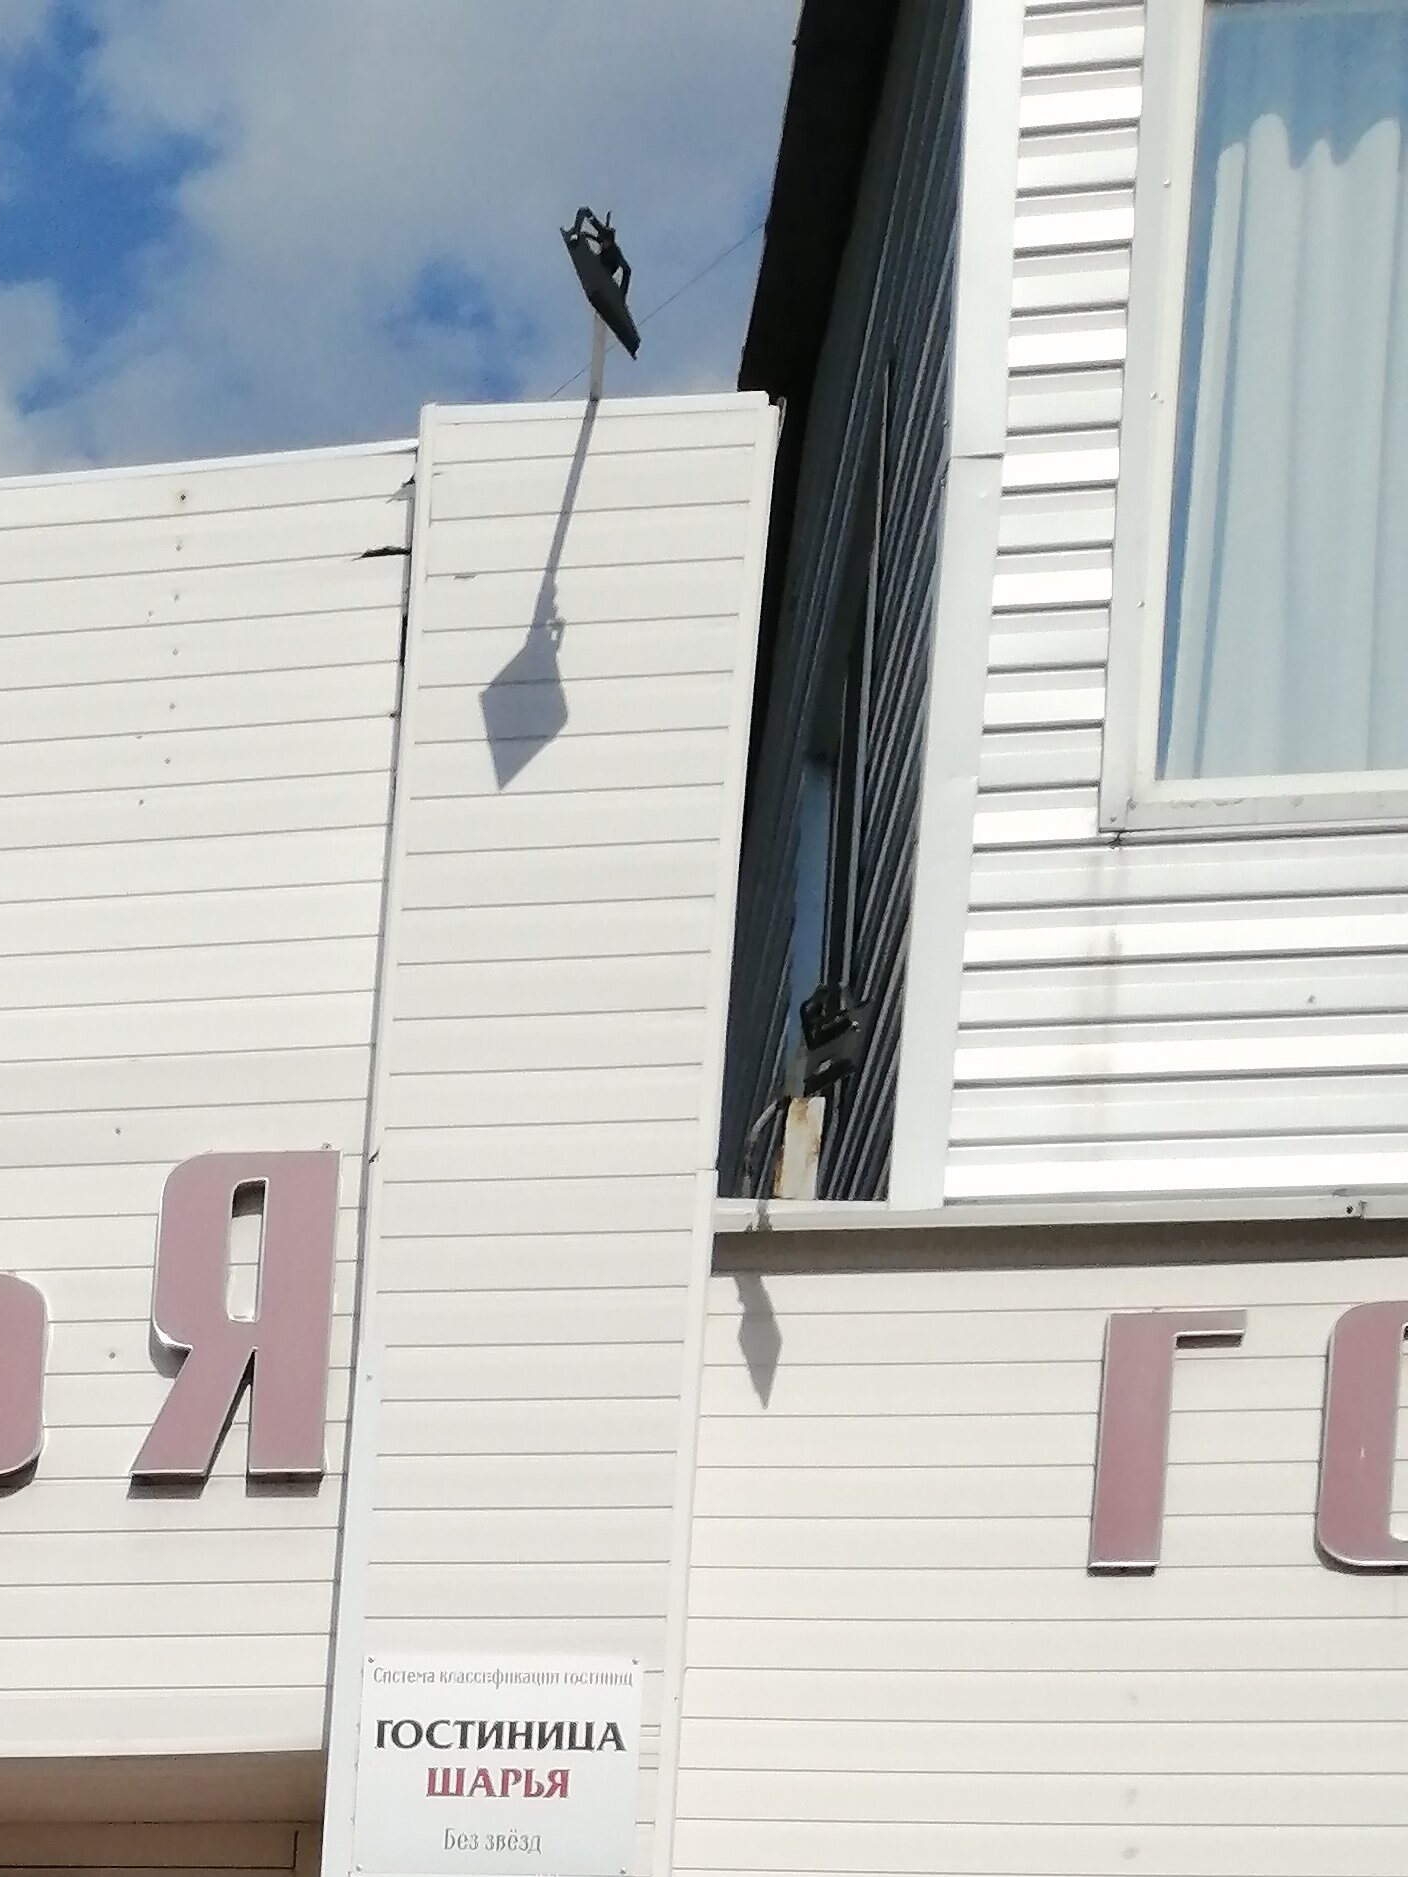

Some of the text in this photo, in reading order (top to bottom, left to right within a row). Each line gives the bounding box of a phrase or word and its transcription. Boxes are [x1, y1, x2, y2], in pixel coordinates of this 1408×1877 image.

[373, 1667, 435, 1684] Система
[439, 1668, 560, 1690] классификации
[374, 1719, 628, 1753] ГОСТИНИЦА
[425, 1767, 571, 1799] ШАРЬЯ
[443, 1828, 543, 1855] Без звёзд
